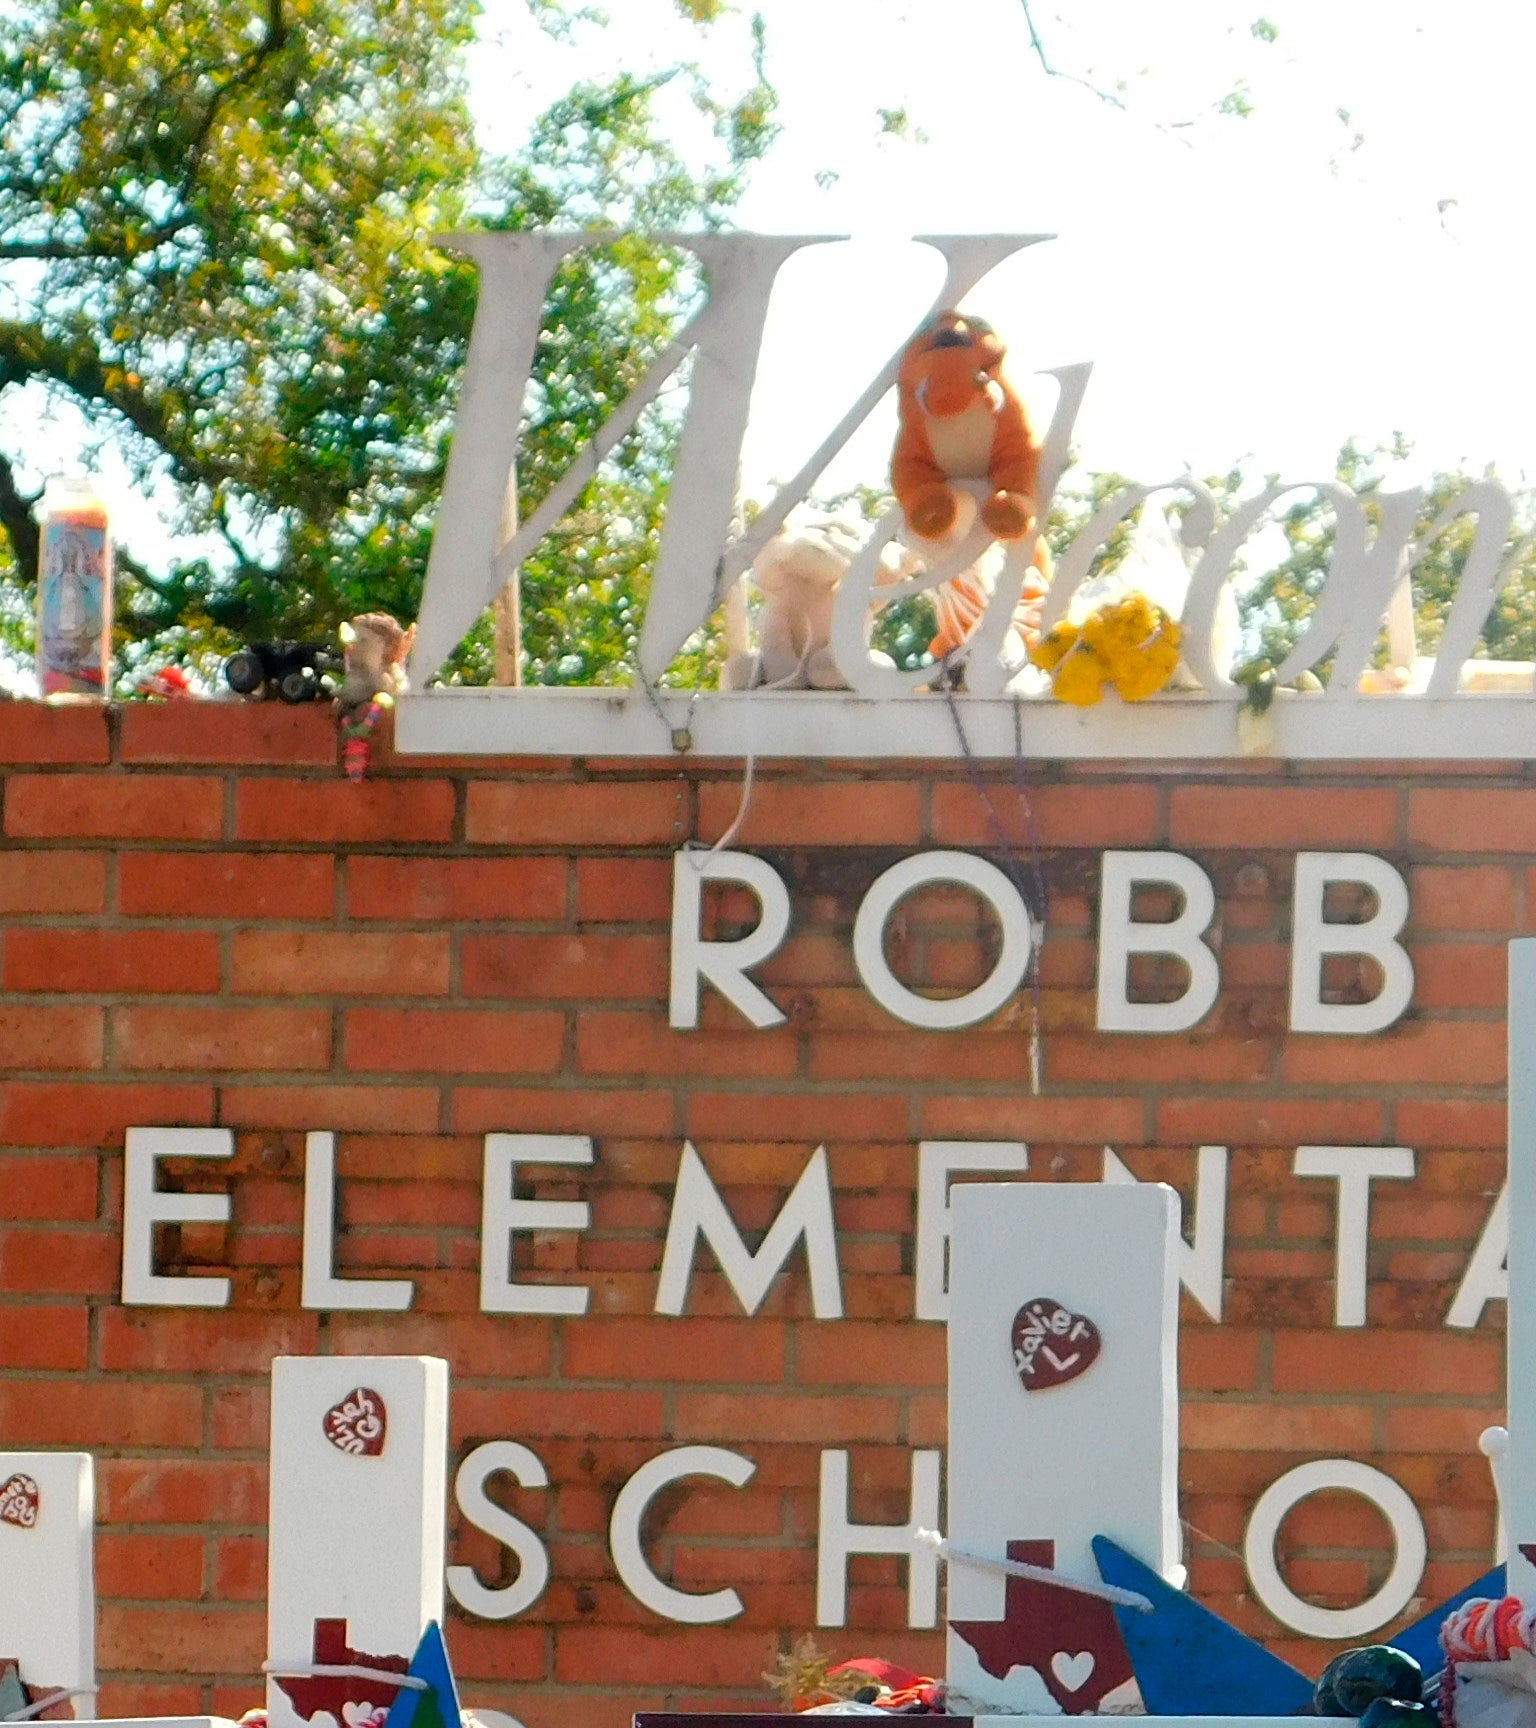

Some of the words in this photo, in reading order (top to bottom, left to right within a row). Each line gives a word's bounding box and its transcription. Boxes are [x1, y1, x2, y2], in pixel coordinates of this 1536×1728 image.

[670, 849, 1415, 1036] ROBB
[1014, 1303, 1092, 1374] Xavier
[1041, 1345, 1081, 1371] L
[447, 1438, 1429, 1642] SCHO
